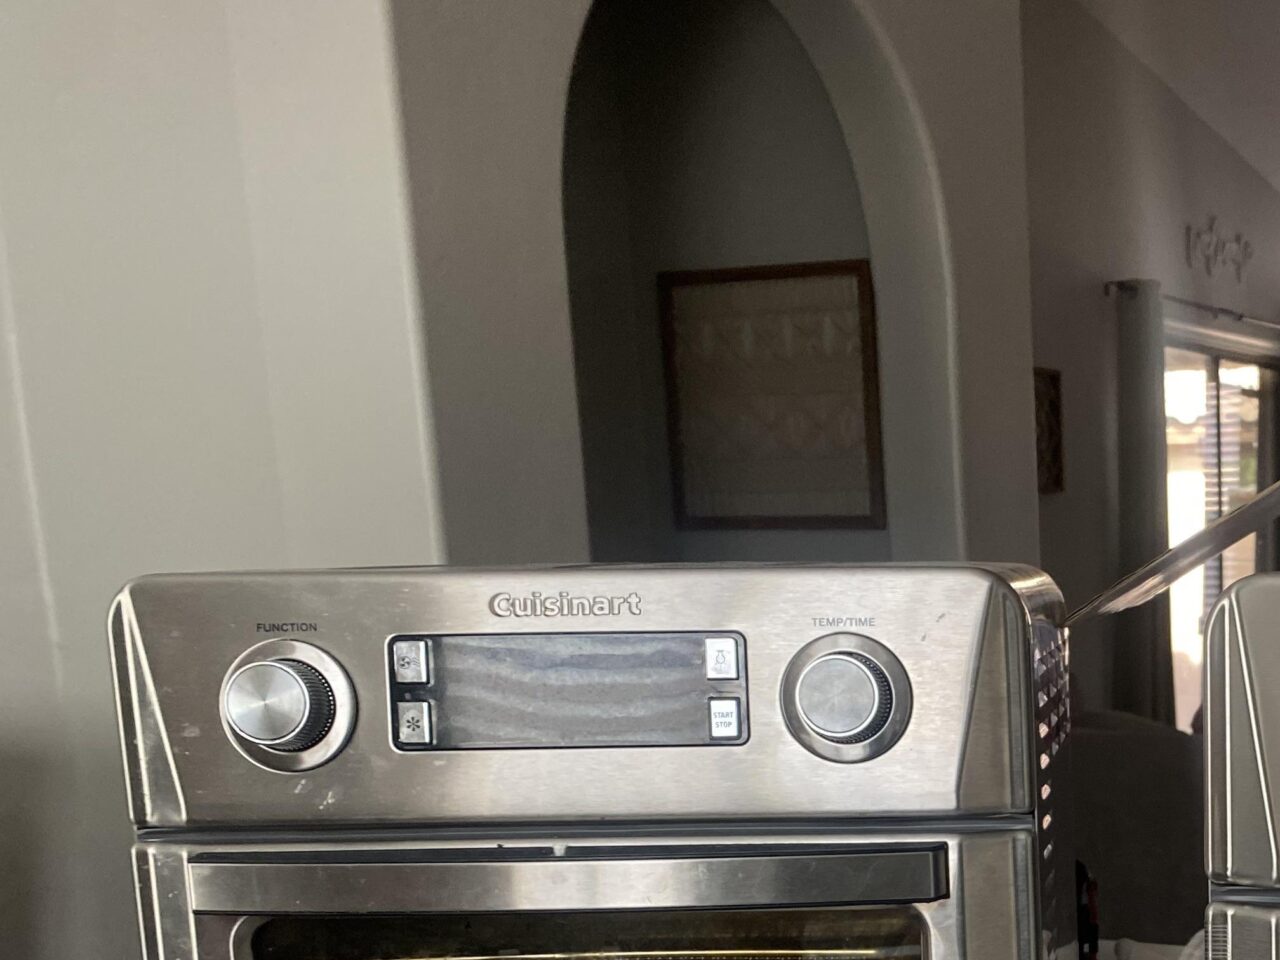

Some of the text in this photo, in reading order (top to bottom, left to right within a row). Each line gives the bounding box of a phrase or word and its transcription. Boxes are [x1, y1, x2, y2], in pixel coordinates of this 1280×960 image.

[489, 592, 642, 618] Cuisinart
[811, 617, 876, 627] TEMP/TIME
[256, 622, 317, 633] FUNCTION
[713, 711, 734, 719] START
[715, 721, 733, 729] STOP
